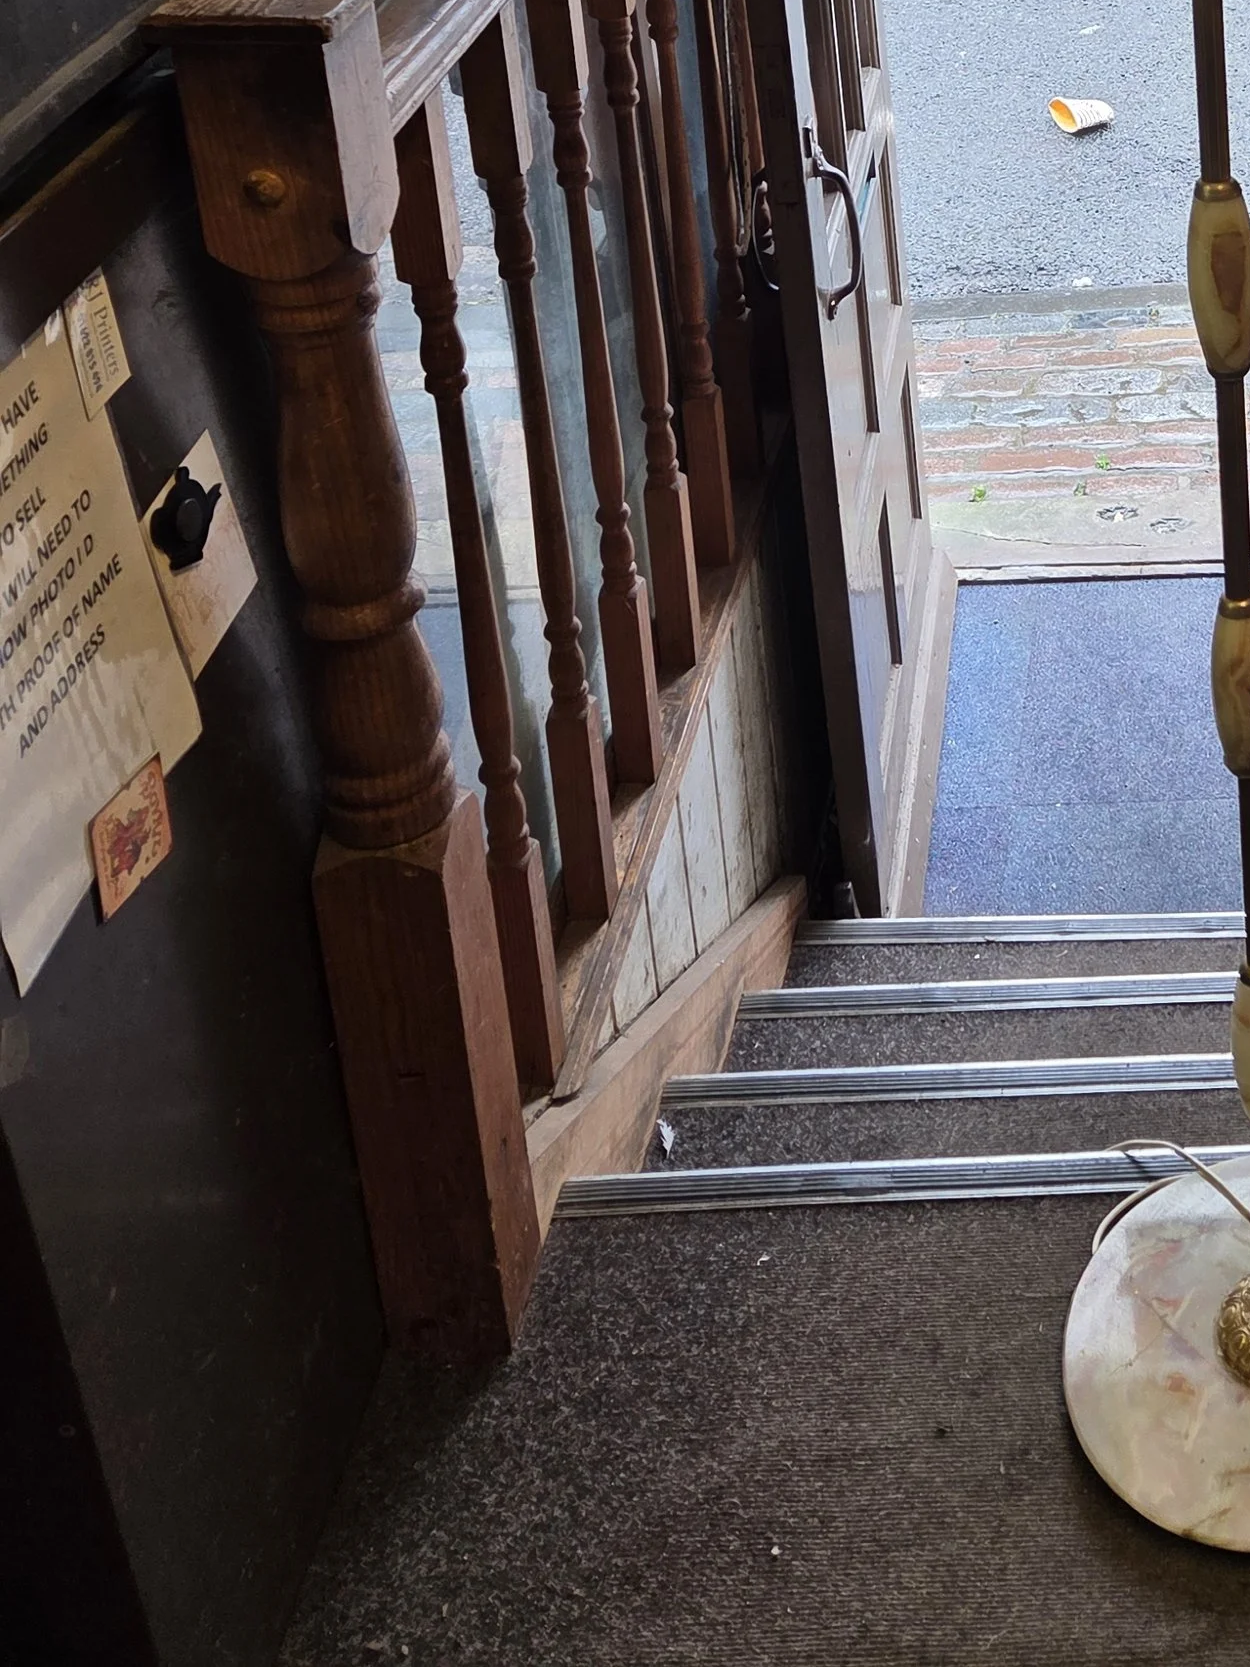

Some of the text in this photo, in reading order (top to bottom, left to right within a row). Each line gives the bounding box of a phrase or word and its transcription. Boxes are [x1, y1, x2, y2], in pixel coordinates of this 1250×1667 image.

[93, 307, 120, 378] Printers
[1, 380, 39, 435] HAVE
[2, 489, 91, 608] WILL NEED TO
[17, 486, 46, 532] SELL
[31, 556, 75, 627] PHOTO
[76, 551, 83, 567] I
[84, 533, 94, 555] D
[17, 630, 61, 704] PROOF
[62, 605, 82, 638] OF
[82, 553, 123, 609] NAME
[19, 624, 106, 758] AND ADDRESS
